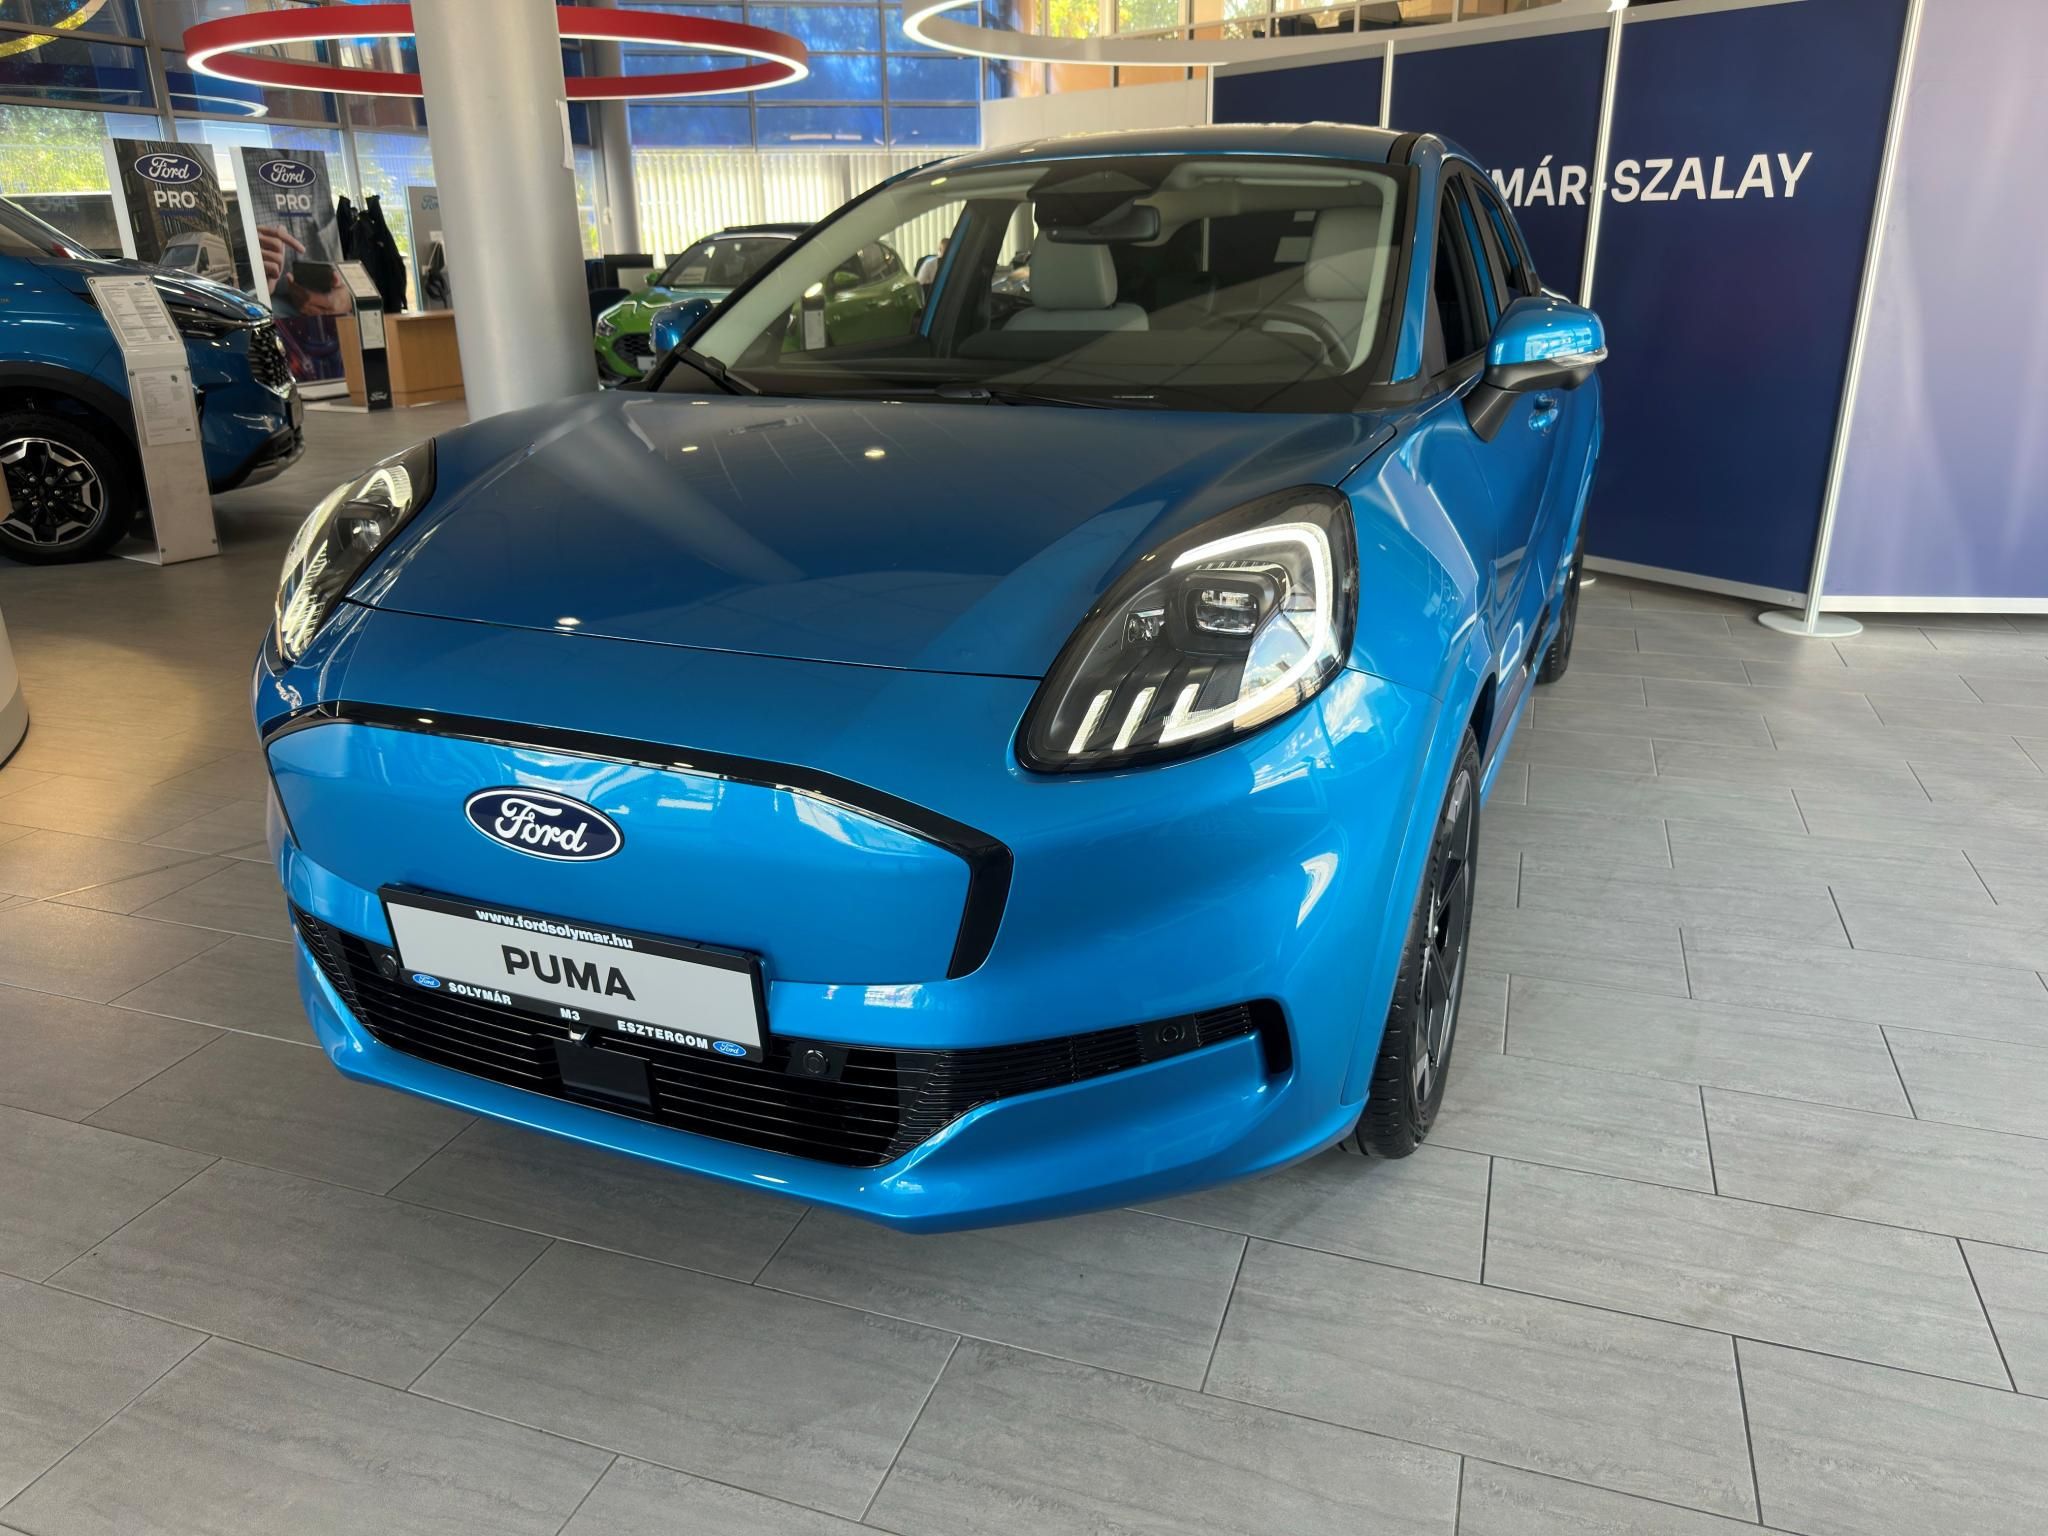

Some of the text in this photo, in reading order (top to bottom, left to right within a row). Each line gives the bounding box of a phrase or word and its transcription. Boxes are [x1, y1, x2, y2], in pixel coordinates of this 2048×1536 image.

[149, 156, 190, 179] Ford
[270, 162, 305, 184] Ford
[1486, 152, 1813, 207] MÁR-SZALAY
[154, 190, 195, 208] PRO
[275, 193, 311, 210] PRO
[495, 798, 587, 852] Ford
[475, 909, 634, 949] www.fordsolymar.hu
[501, 944, 636, 1001] PUMA
[448, 982, 512, 1005] SOLYMÁR
[559, 1007, 581, 1021] M3
[617, 1020, 708, 1049] ESZTERGOM
